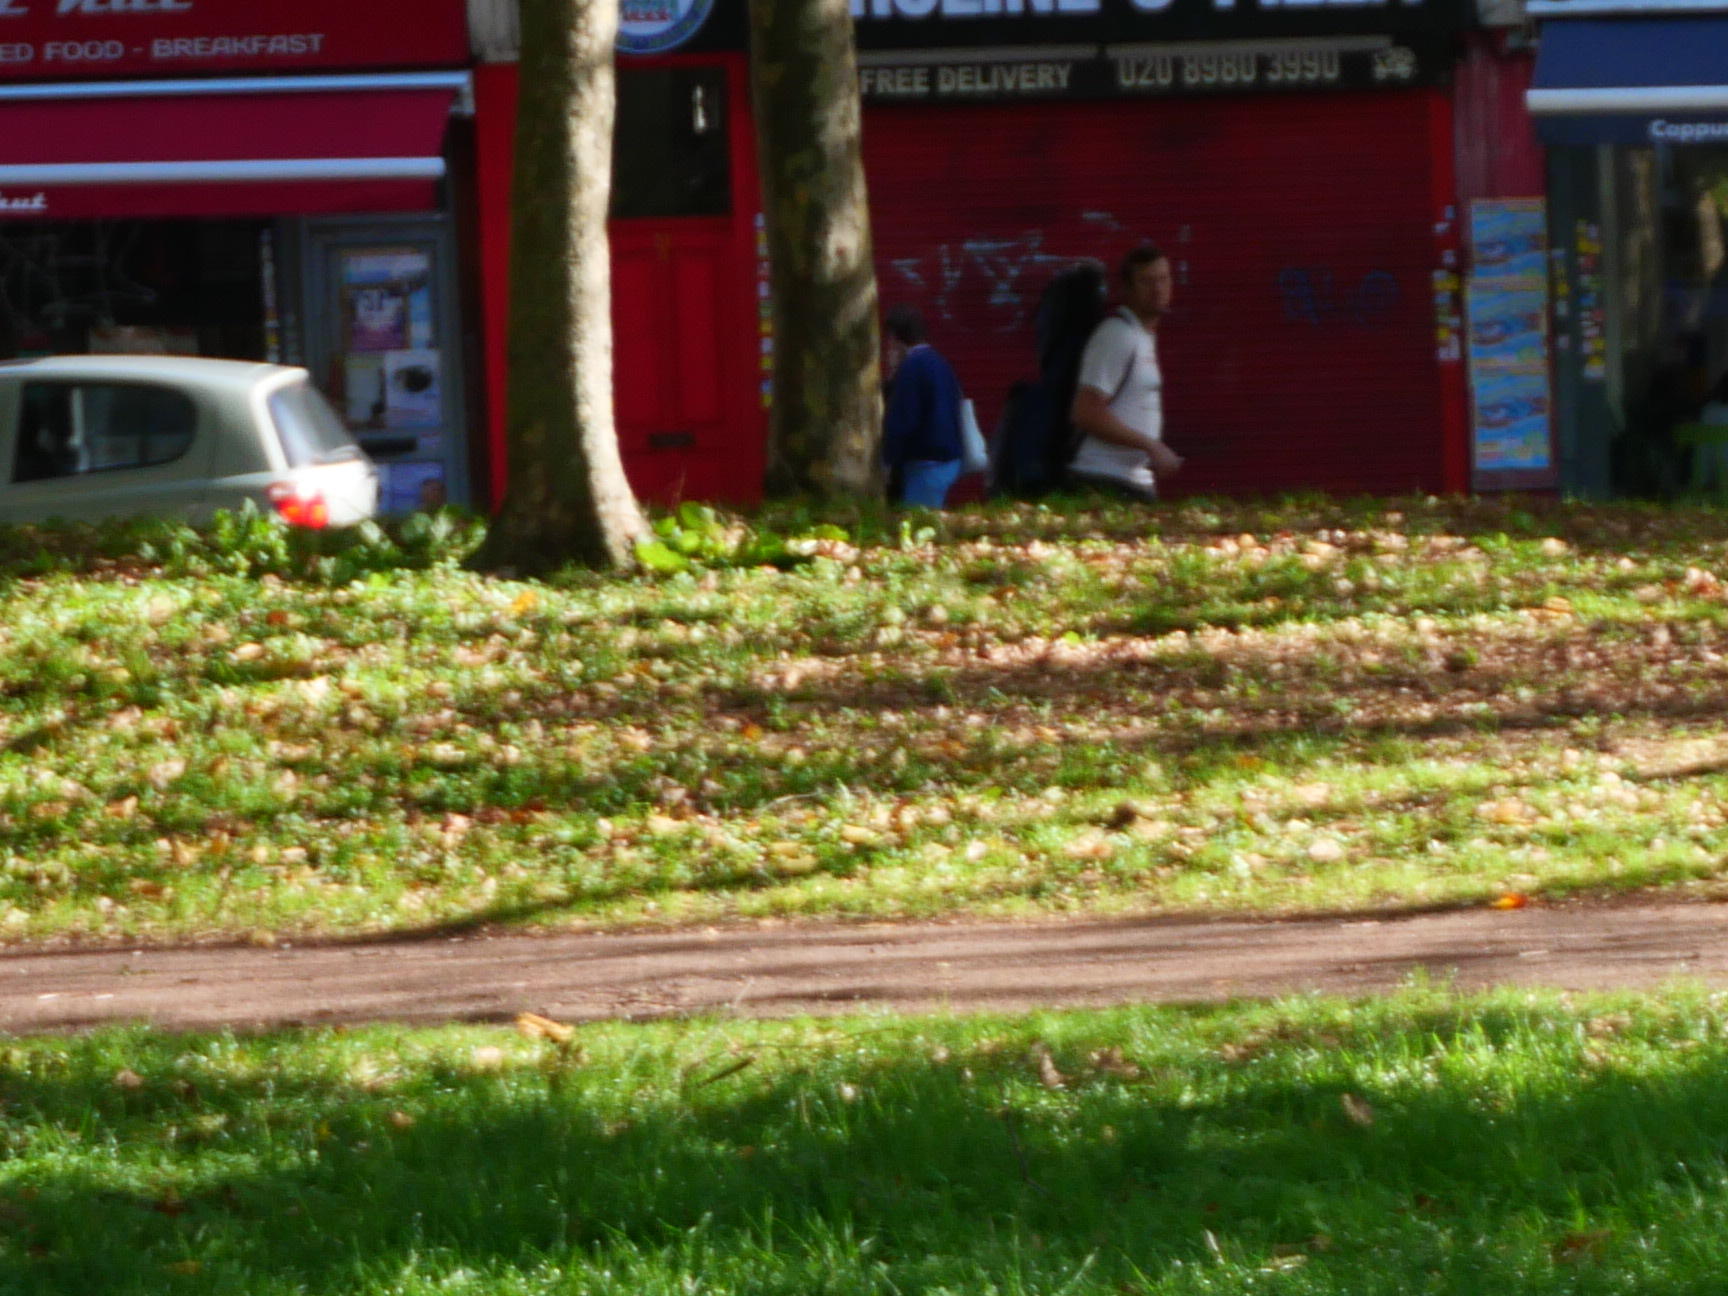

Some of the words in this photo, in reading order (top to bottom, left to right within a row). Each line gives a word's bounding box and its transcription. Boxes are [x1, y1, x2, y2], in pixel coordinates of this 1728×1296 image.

[44, 40, 124, 60] FOOD
[152, 33, 325, 58] BREAKFAST
[860, 68, 930, 95] FREE
[937, 62, 1073, 92] DELIVERY
[1119, 54, 1174, 89] 020
[1183, 51, 1256, 85] 8980
